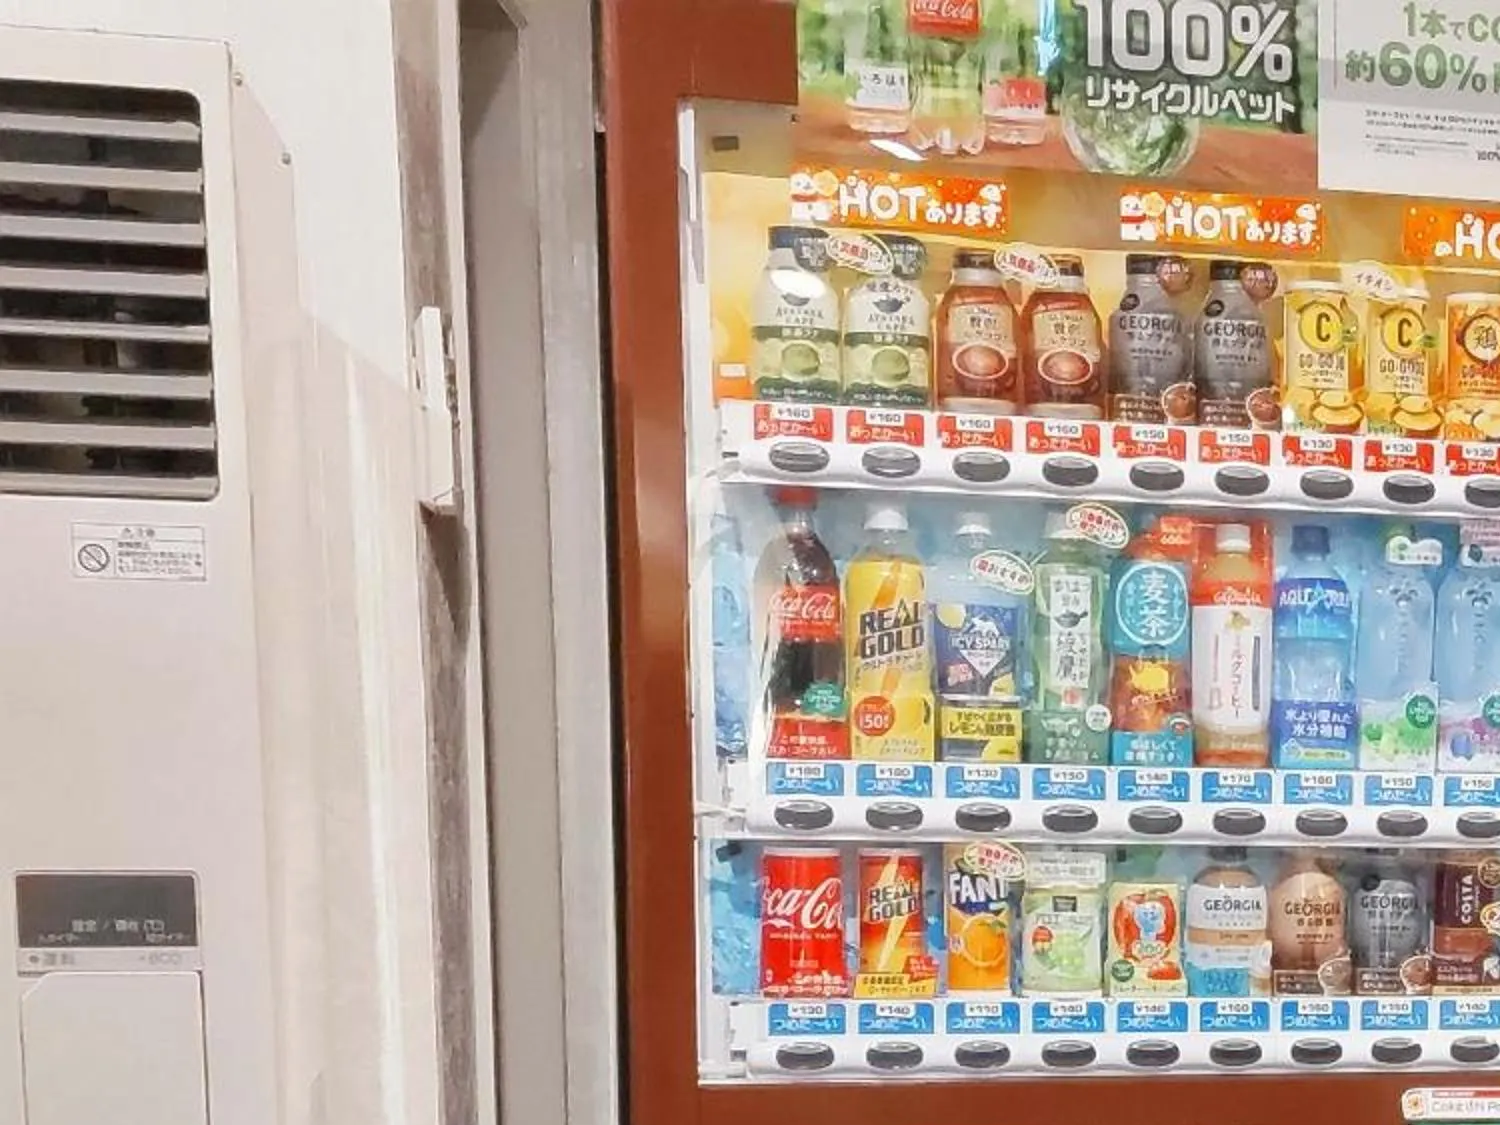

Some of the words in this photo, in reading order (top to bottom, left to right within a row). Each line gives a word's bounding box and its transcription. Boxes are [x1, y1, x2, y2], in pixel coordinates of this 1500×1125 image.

[1072, 0, 1293, 82] 100%
[1085, 75, 1296, 122] リサイクルペット
[1316, 312, 1331, 342] C
[1398, 318, 1412, 348] C
[860, 600, 924, 635] REAL
[1140, 573, 1171, 637] 麦茶
[860, 625, 925, 660] GOLD
